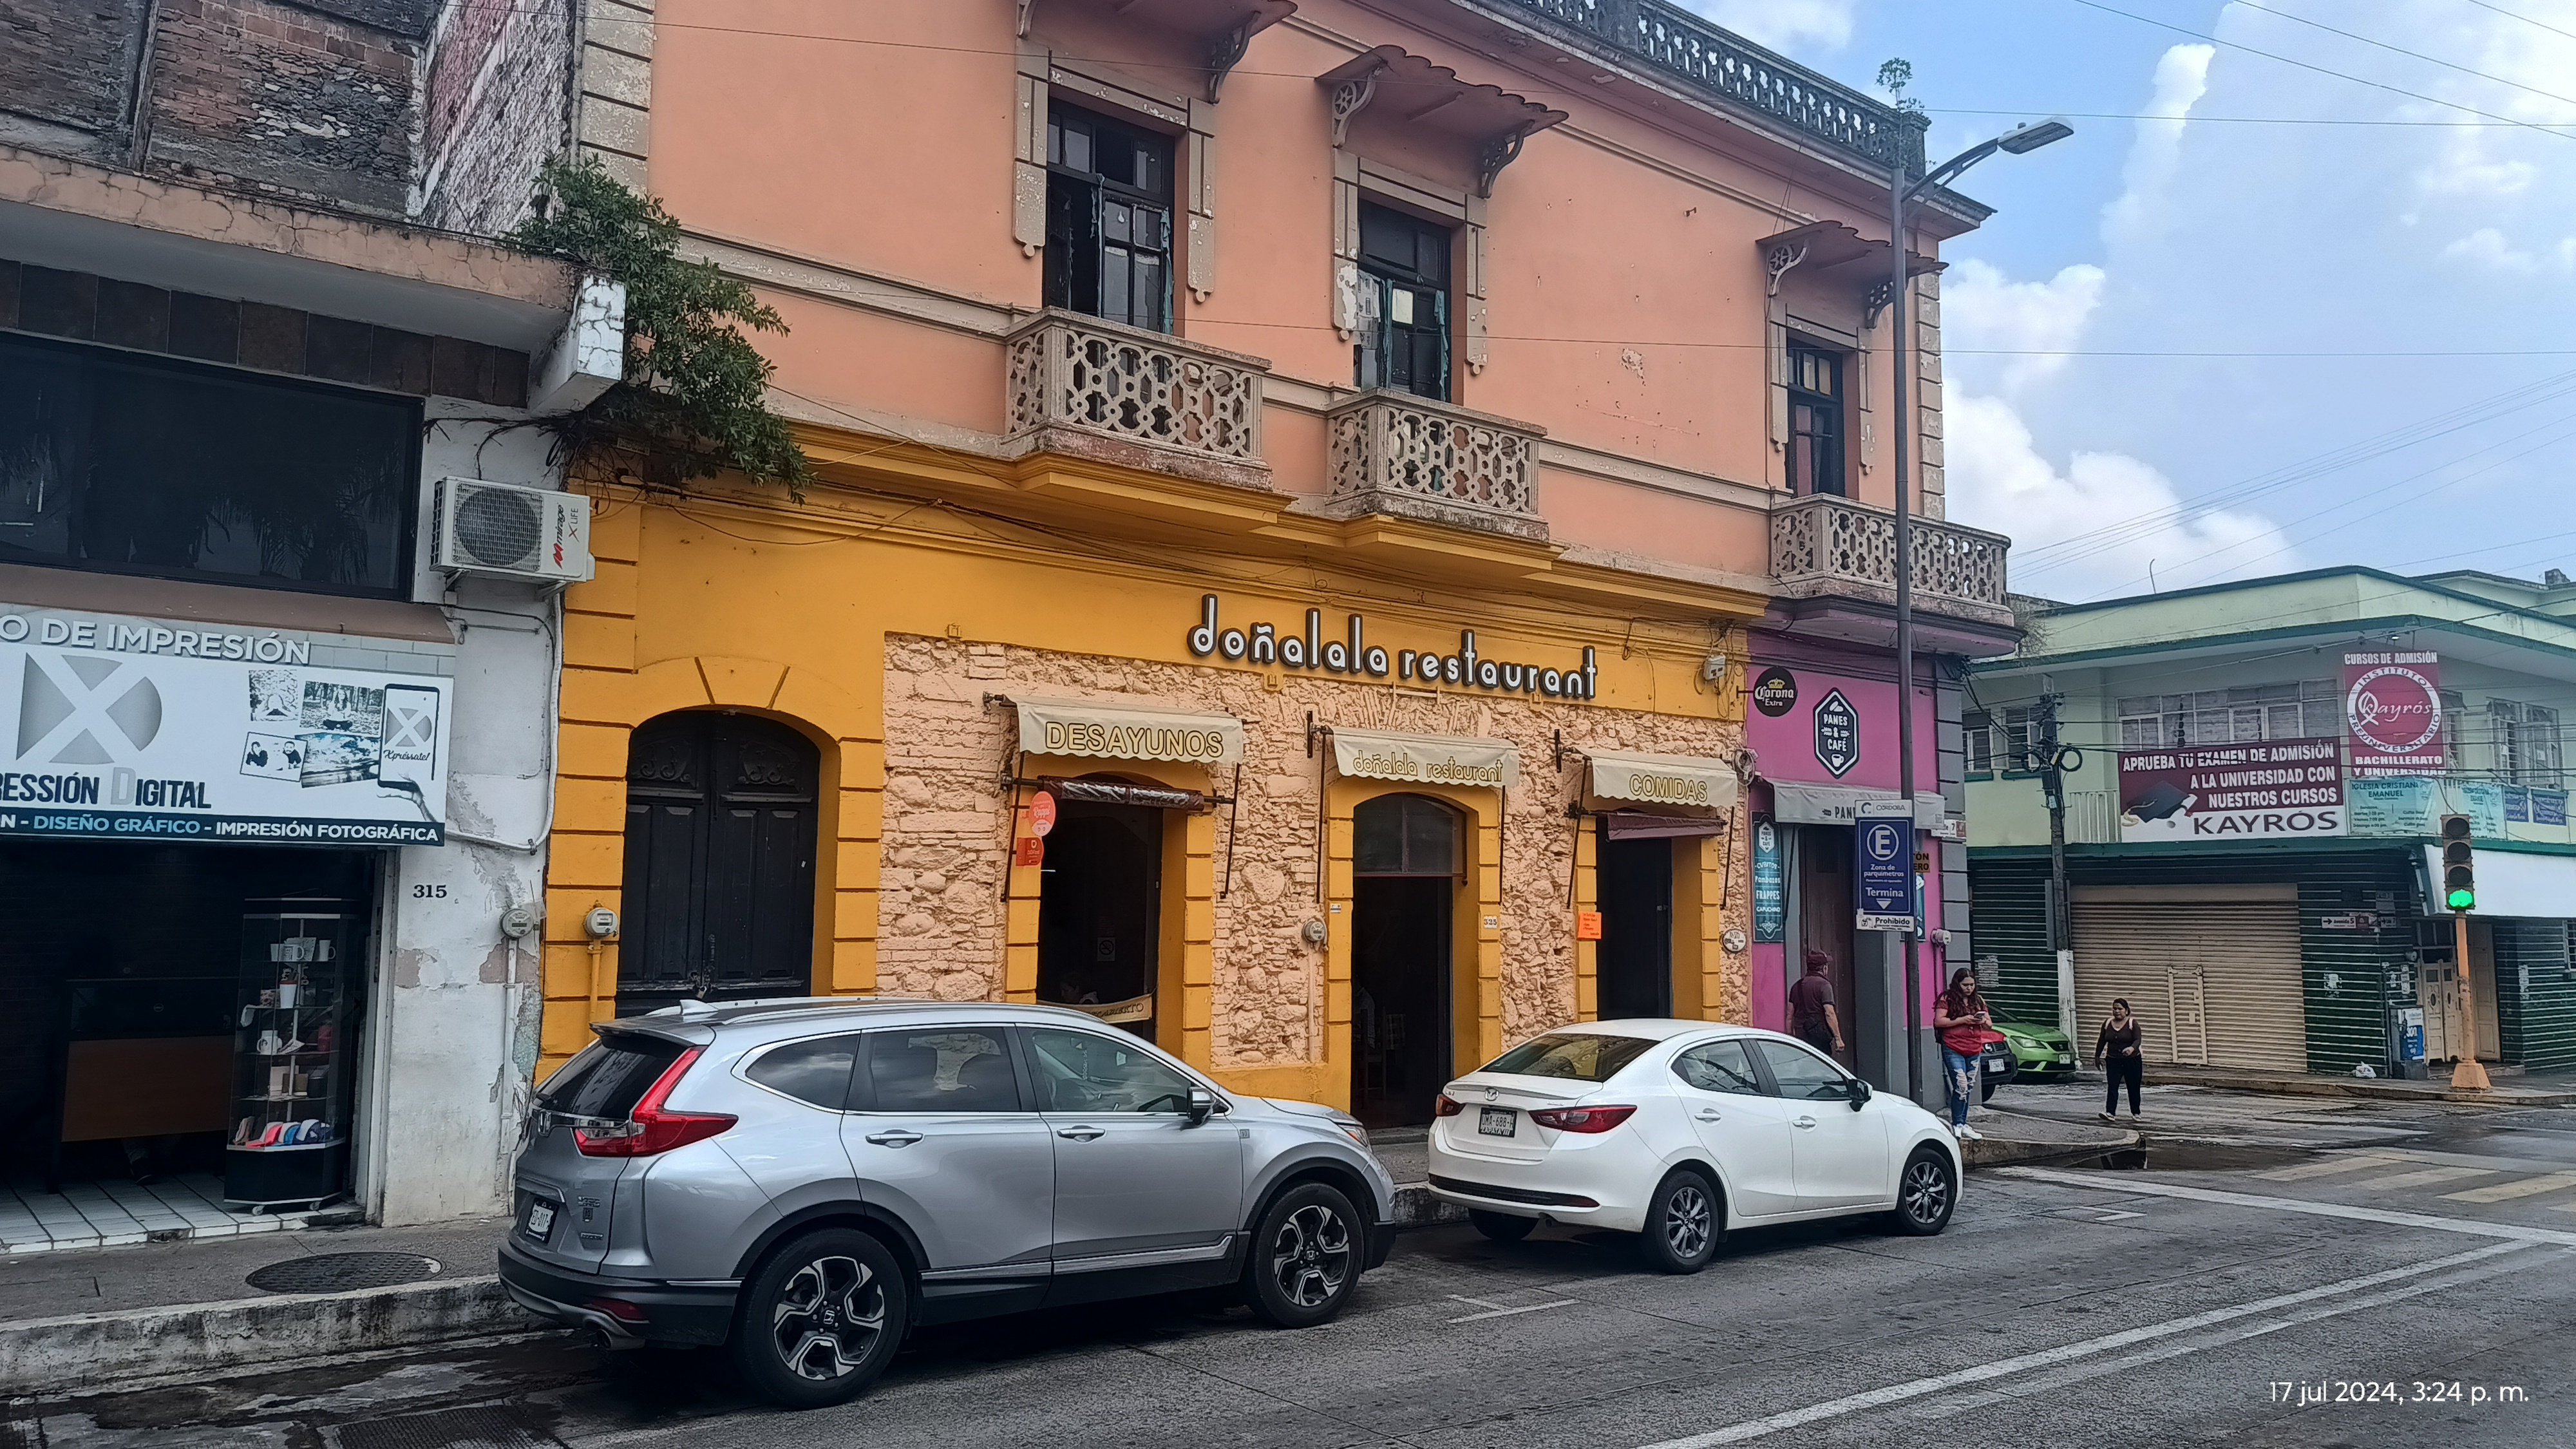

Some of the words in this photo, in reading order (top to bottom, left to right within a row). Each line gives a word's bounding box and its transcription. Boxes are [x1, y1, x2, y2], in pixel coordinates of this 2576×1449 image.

[556, 504, 565, 545] mirage
[41, 618, 97, 648] DE
[106, 623, 311, 665] IMPRESIÓN
[1187, 594, 1389, 676] doñalala
[1398, 629, 1597, 699] restaurant
[2345, 654, 2379, 665] CURSOS
[2380, 653, 2391, 664] DE
[2394, 650, 2438, 664] ADMISIÓN
[2358, 667, 2427, 687] INSTITUTO
[1754, 686, 1794, 701] Corona
[1824, 714, 1848, 726] PANES
[1045, 721, 1224, 757] DESAYUNOS
[1833, 727, 1839, 737] &
[2349, 714, 2439, 752] PREUNIVERSITARIO
[1828, 738, 1847, 752] CAFÉ
[2123, 755, 2175, 772] APRUEBA
[2178, 754, 2193, 768] TU
[2197, 749, 2246, 766] EXAMEN
[2250, 748, 2267, 762] DE
[2271, 740, 2334, 761] ADMISIÓN
[2355, 756, 2443, 765] BACHILLERATO
[1353, 750, 1417, 776] doñalala
[1426, 756, 1503, 782] restaurant
[2363, 768, 2447, 776] UNIVERSIDAD
[2190, 774, 2199, 790] A
[2201, 774, 2217, 788] LA
[2221, 768, 2304, 788] UNIVERSIDAD
[2307, 766, 2336, 782] CON
[111, 767, 211, 809] DIGITAL
[1629, 774, 1707, 802] COMIDAS
[2208, 791, 2278, 808] NUESTROS
[2281, 787, 2337, 804] CURSOS
[1835, 806, 1855, 819] PAN
[33, 814, 109, 831] DISEÑO
[114, 816, 200, 833] GRÁFICO
[216, 820, 313, 838] IMPRESIÓN
[318, 824, 439, 841] FOTOGRÁFICA
[2193, 810, 2338, 835] KAYRÓS
[1875, 830, 1891, 855] E
[1913, 850, 1929, 860] ÓN
[413, 884, 448, 899] 315
[1756, 890, 1780, 900] FRAPPES
[1865, 887, 1904, 897] Termina
[1484, 918, 1497, 926] 325
[1875, 917, 1910, 925] Prohibido
[1481, 1126, 1501, 1135] ZAPATA
